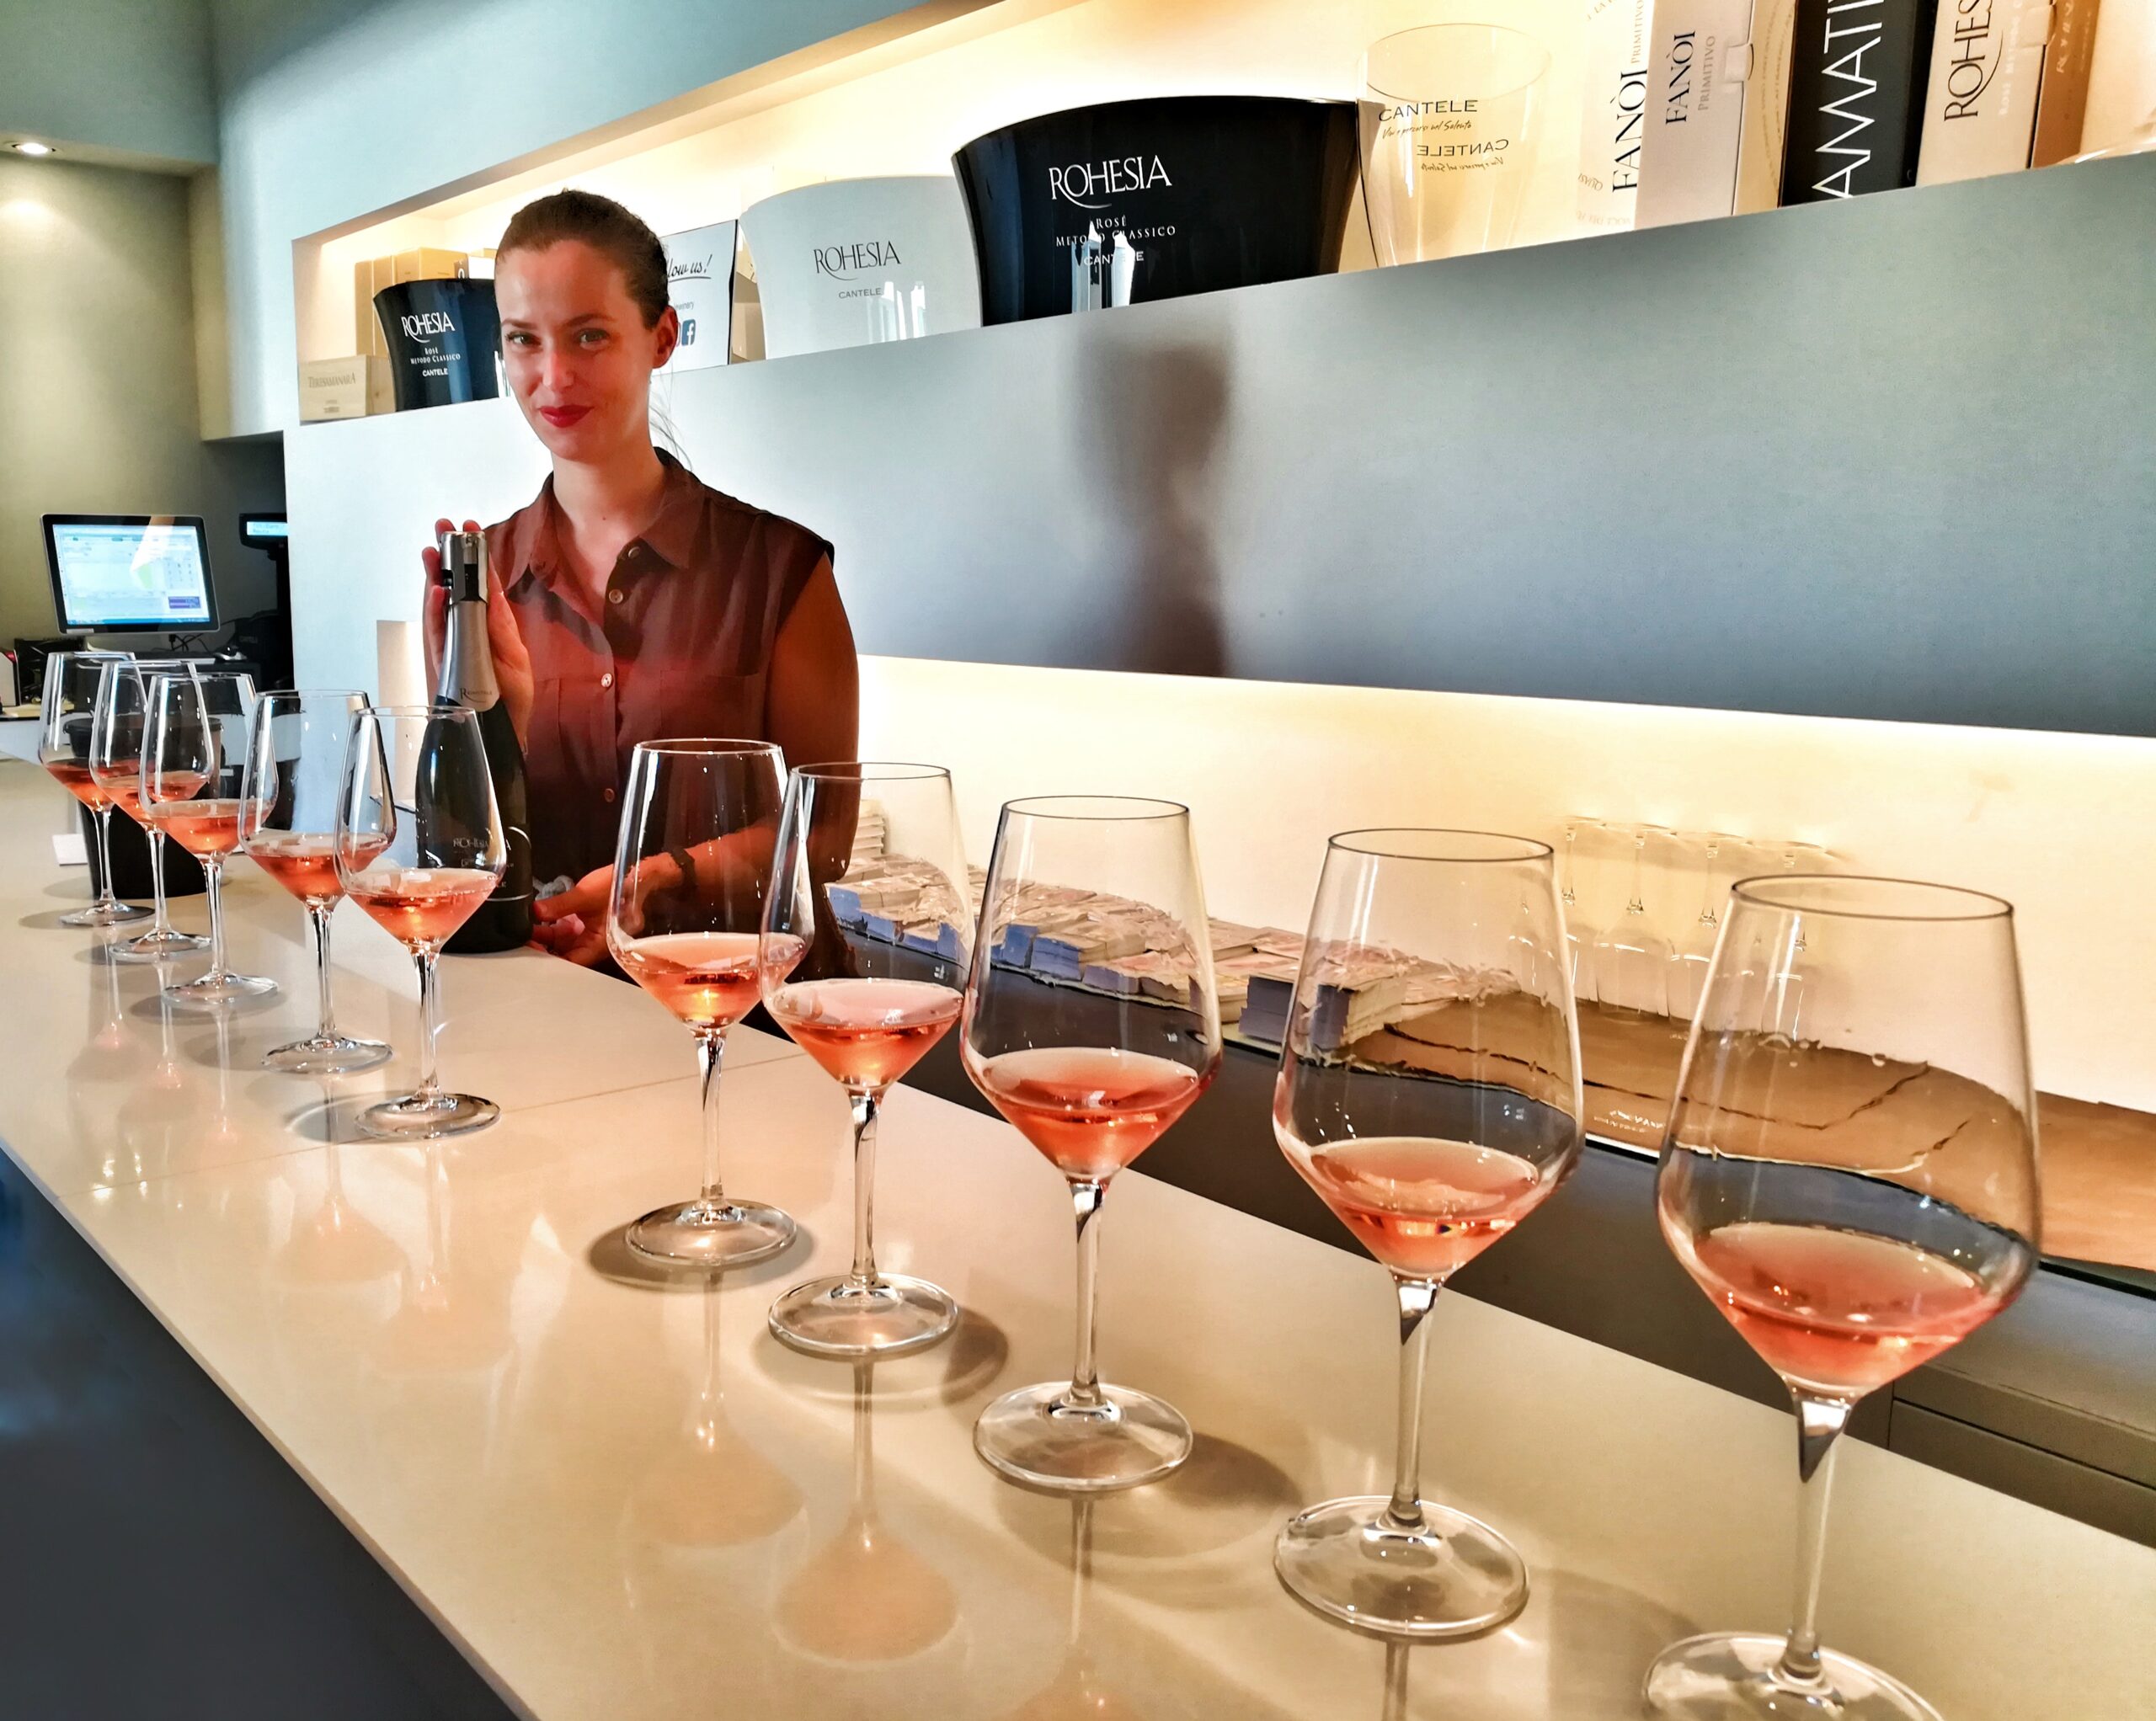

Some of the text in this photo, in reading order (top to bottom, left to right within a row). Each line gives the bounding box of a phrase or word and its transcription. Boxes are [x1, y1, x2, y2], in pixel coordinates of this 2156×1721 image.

[1665, 31, 1696, 125] FANÒI
[1697, 35, 1716, 111] PRIMITIVO
[1379, 99, 1479, 121] CANTELE
[1812, 0, 1885, 198] AMATI
[1049, 155, 1172, 209] ROHESIA
[814, 240, 902, 281] ROHESIA
[1083, 251, 1145, 266] CANE
[839, 287, 882, 299] CANTELE
[401, 312, 456, 343] ROHESIA
[422, 368, 449, 377] CANTELE
